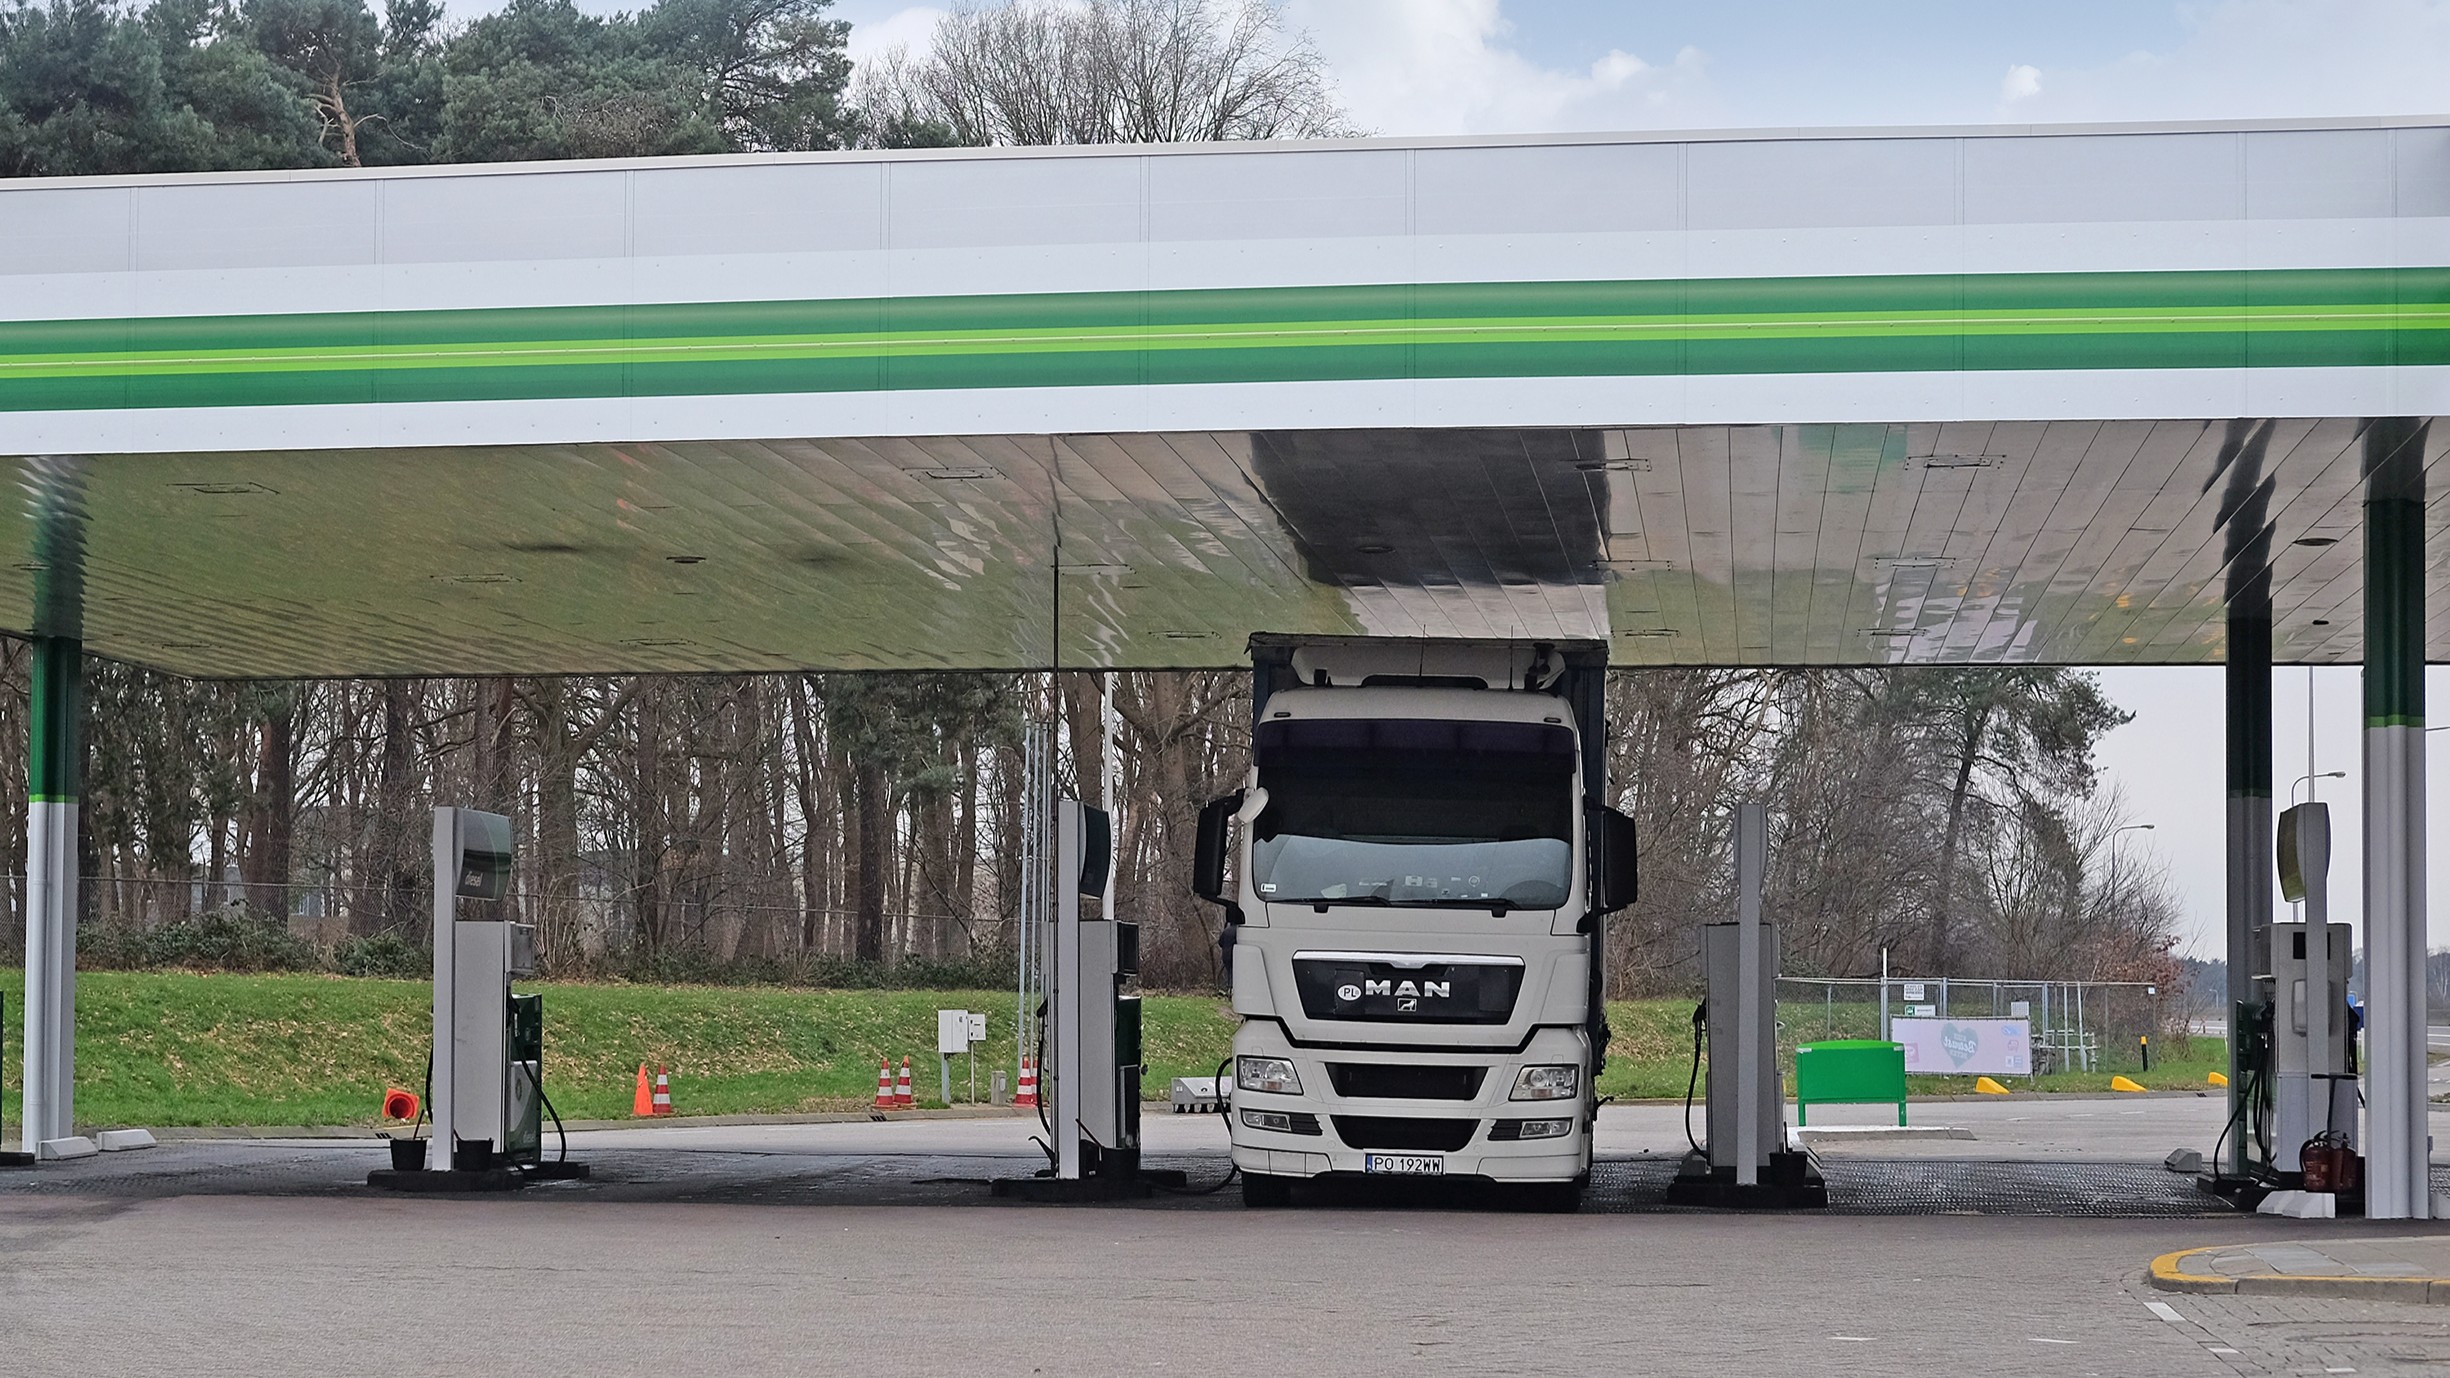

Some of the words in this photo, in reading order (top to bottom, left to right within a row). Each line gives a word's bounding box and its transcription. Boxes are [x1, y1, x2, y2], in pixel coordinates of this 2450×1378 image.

[465, 871, 483, 887] diesel
[1344, 987, 1357, 998] PL
[1365, 979, 1450, 998] MAN
[1374, 1157, 1393, 1170] PO
[1400, 1158, 1441, 1172] 192WW
